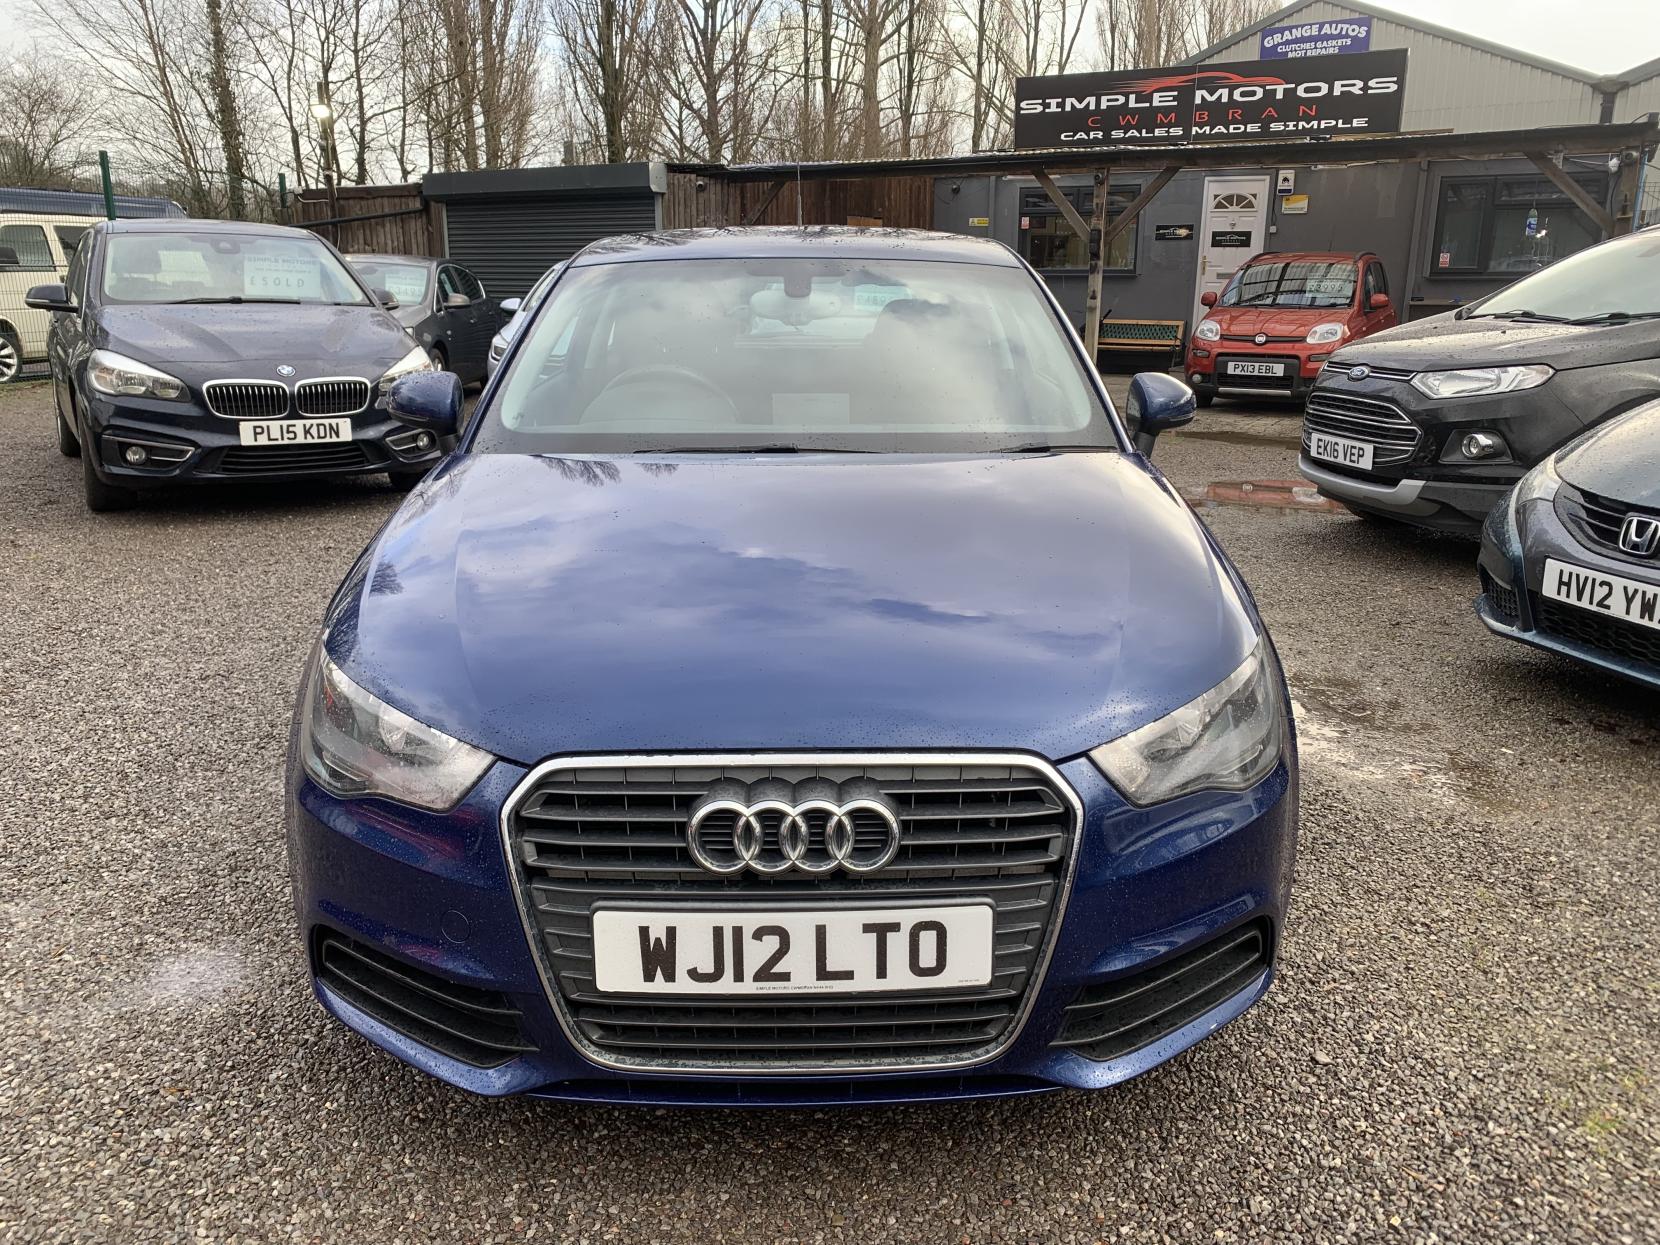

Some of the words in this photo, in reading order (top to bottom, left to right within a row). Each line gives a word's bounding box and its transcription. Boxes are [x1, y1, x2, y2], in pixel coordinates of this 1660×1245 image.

[1264, 24, 1319, 47] GRANGE
[1320, 23, 1368, 38] AUTOS
[1277, 42, 1315, 52] CLUTCHES
[1316, 38, 1352, 48] GASKETS
[1287, 50, 1306, 58] MOT
[1306, 47, 1339, 56] REPAIRS
[1020, 91, 1179, 114] SIMPLE
[1195, 76, 1398, 102] MOTORS
[1088, 104, 1317, 127] CWMBRAN
[1060, 130, 1103, 141] CAR
[1111, 127, 1183, 138] SALES
[1192, 122, 1265, 135] MADE
[1270, 117, 1369, 131] SIMPLE
[1233, 363, 1256, 374] PX13
[1257, 365, 1277, 375] EBL
[253, 423, 297, 442] PL15
[302, 422, 341, 441] KDN
[1316, 438, 1339, 459] EK16
[1342, 443, 1365, 465] VEP
[1556, 568, 1613, 610] HV12
[1623, 585, 1660, 624] YW
[638, 924, 791, 983] WJ12
[815, 920, 947, 982] LTO
